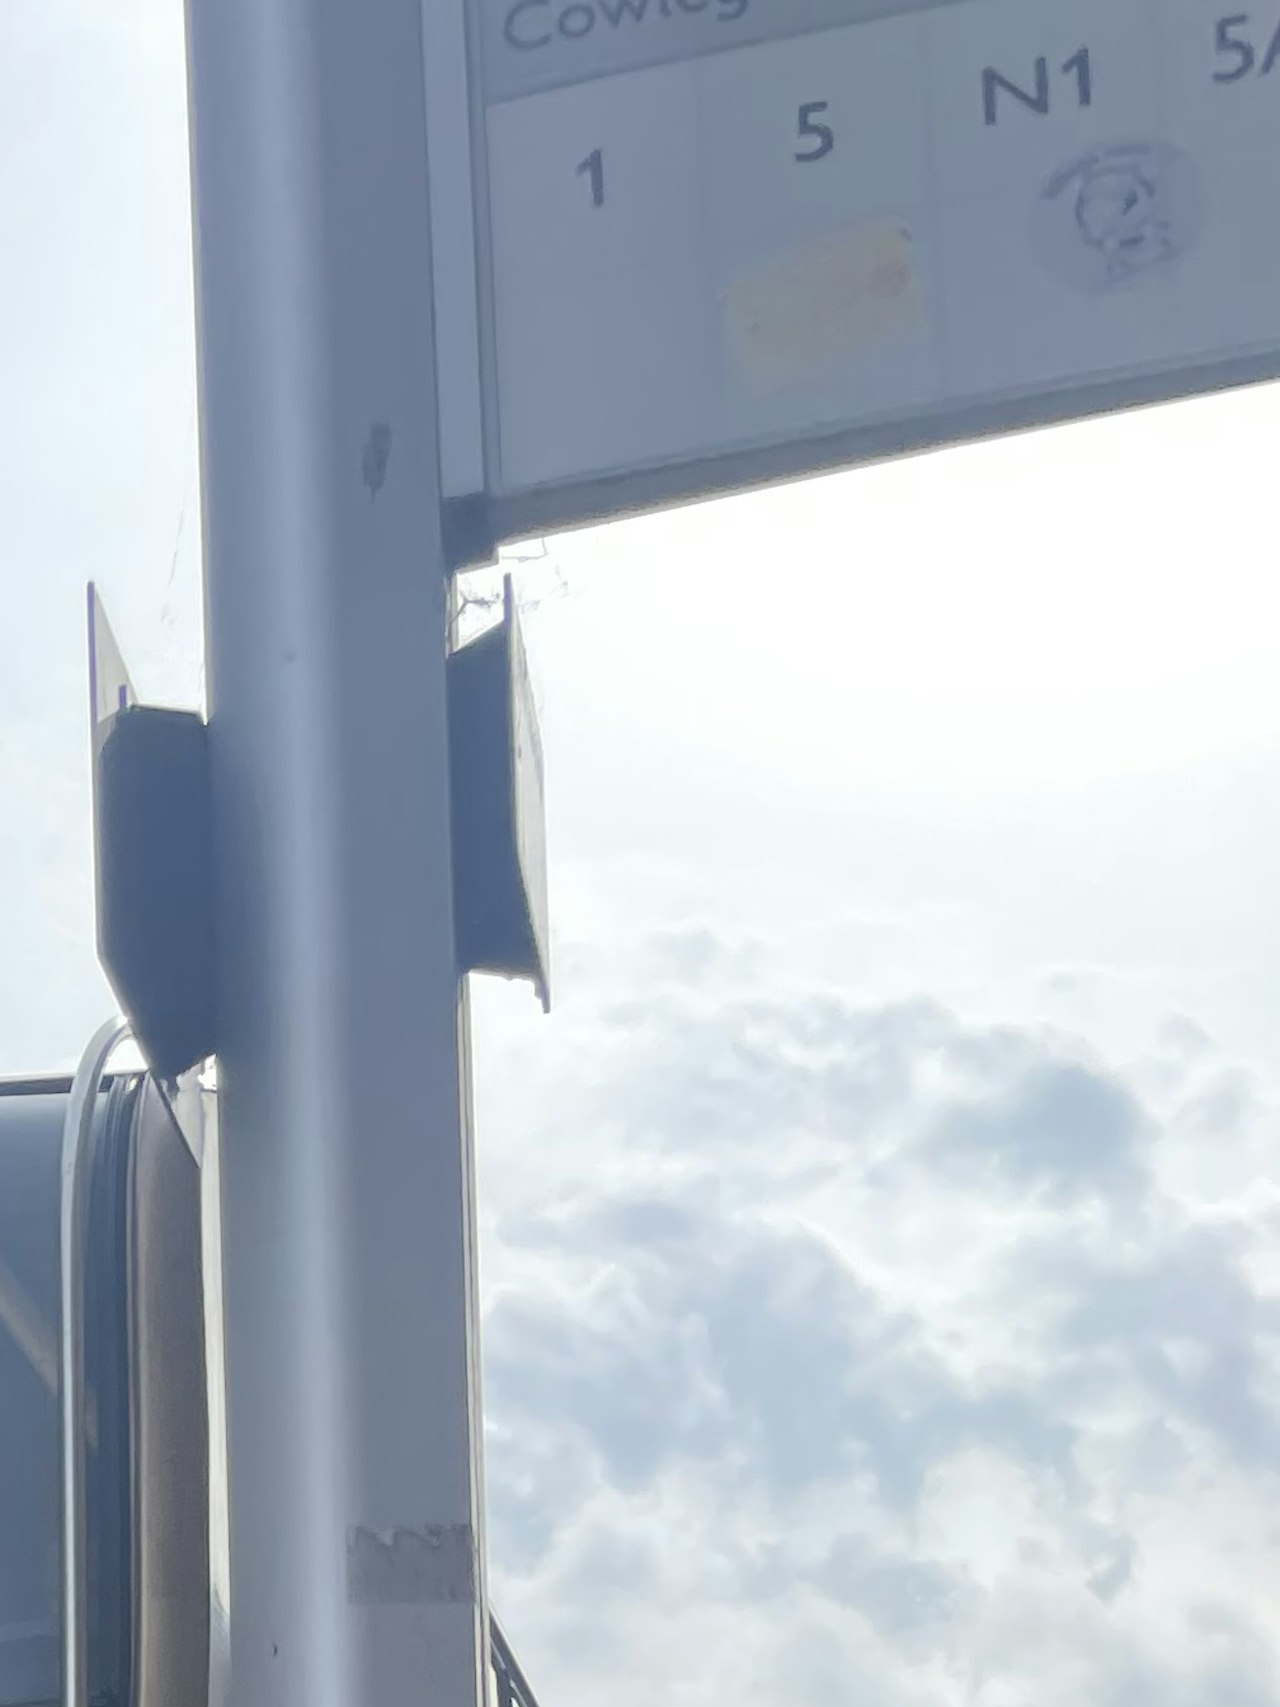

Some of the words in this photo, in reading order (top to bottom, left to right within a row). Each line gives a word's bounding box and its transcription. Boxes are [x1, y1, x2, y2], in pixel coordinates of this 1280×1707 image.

[503, 0, 748, 50] Cow
[576, 149, 604, 207] 1
[794, 101, 834, 163] 5
[981, 45, 1091, 126] N1
